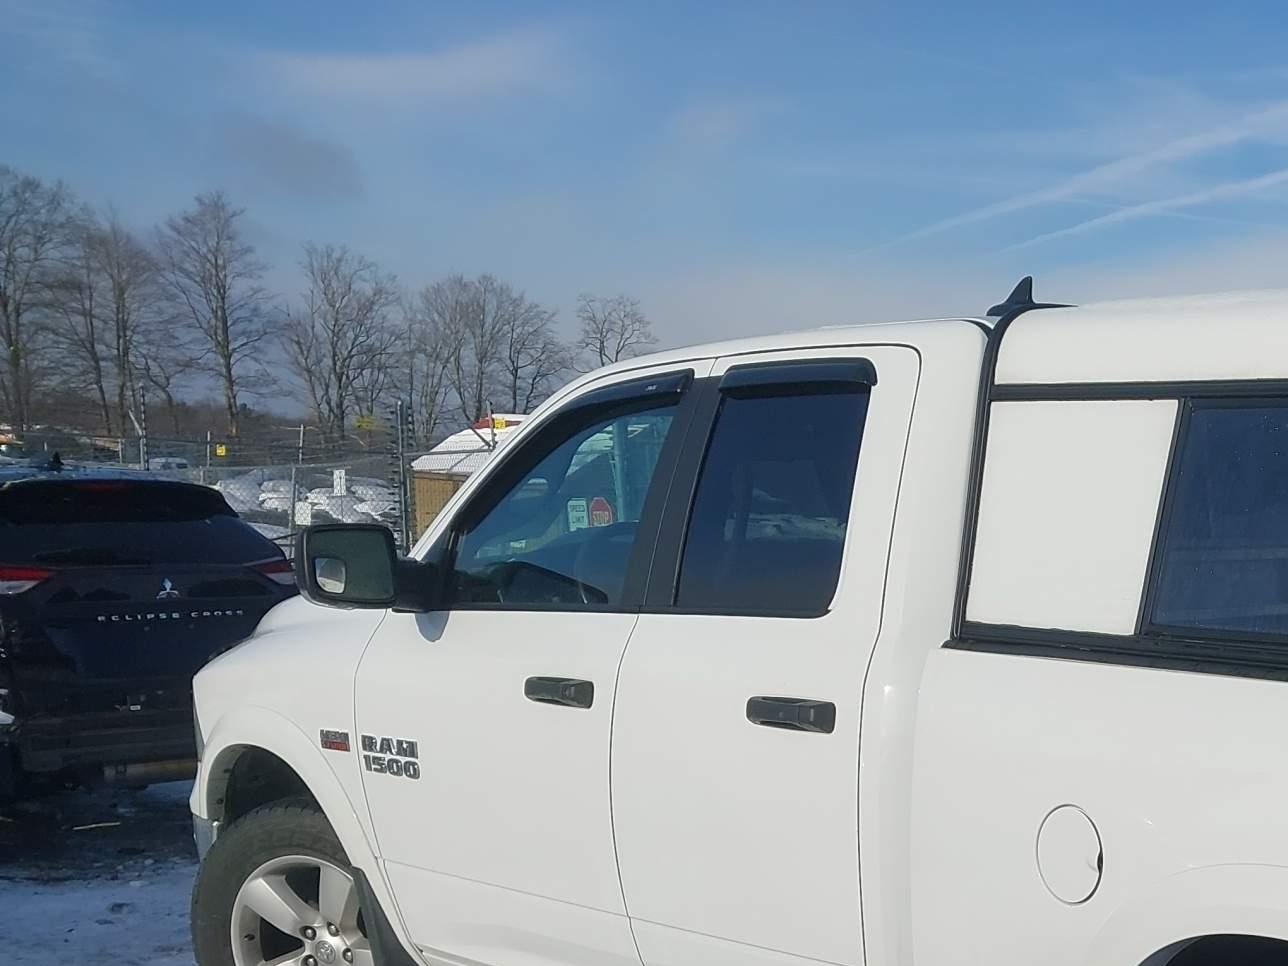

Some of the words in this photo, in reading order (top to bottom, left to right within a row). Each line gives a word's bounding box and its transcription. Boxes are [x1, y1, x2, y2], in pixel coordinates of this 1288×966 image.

[592, 511, 609, 525] STOP
[97, 612, 180, 621] ECLIPSE
[361, 734, 418, 759] RAM
[363, 754, 420, 780] 1500
